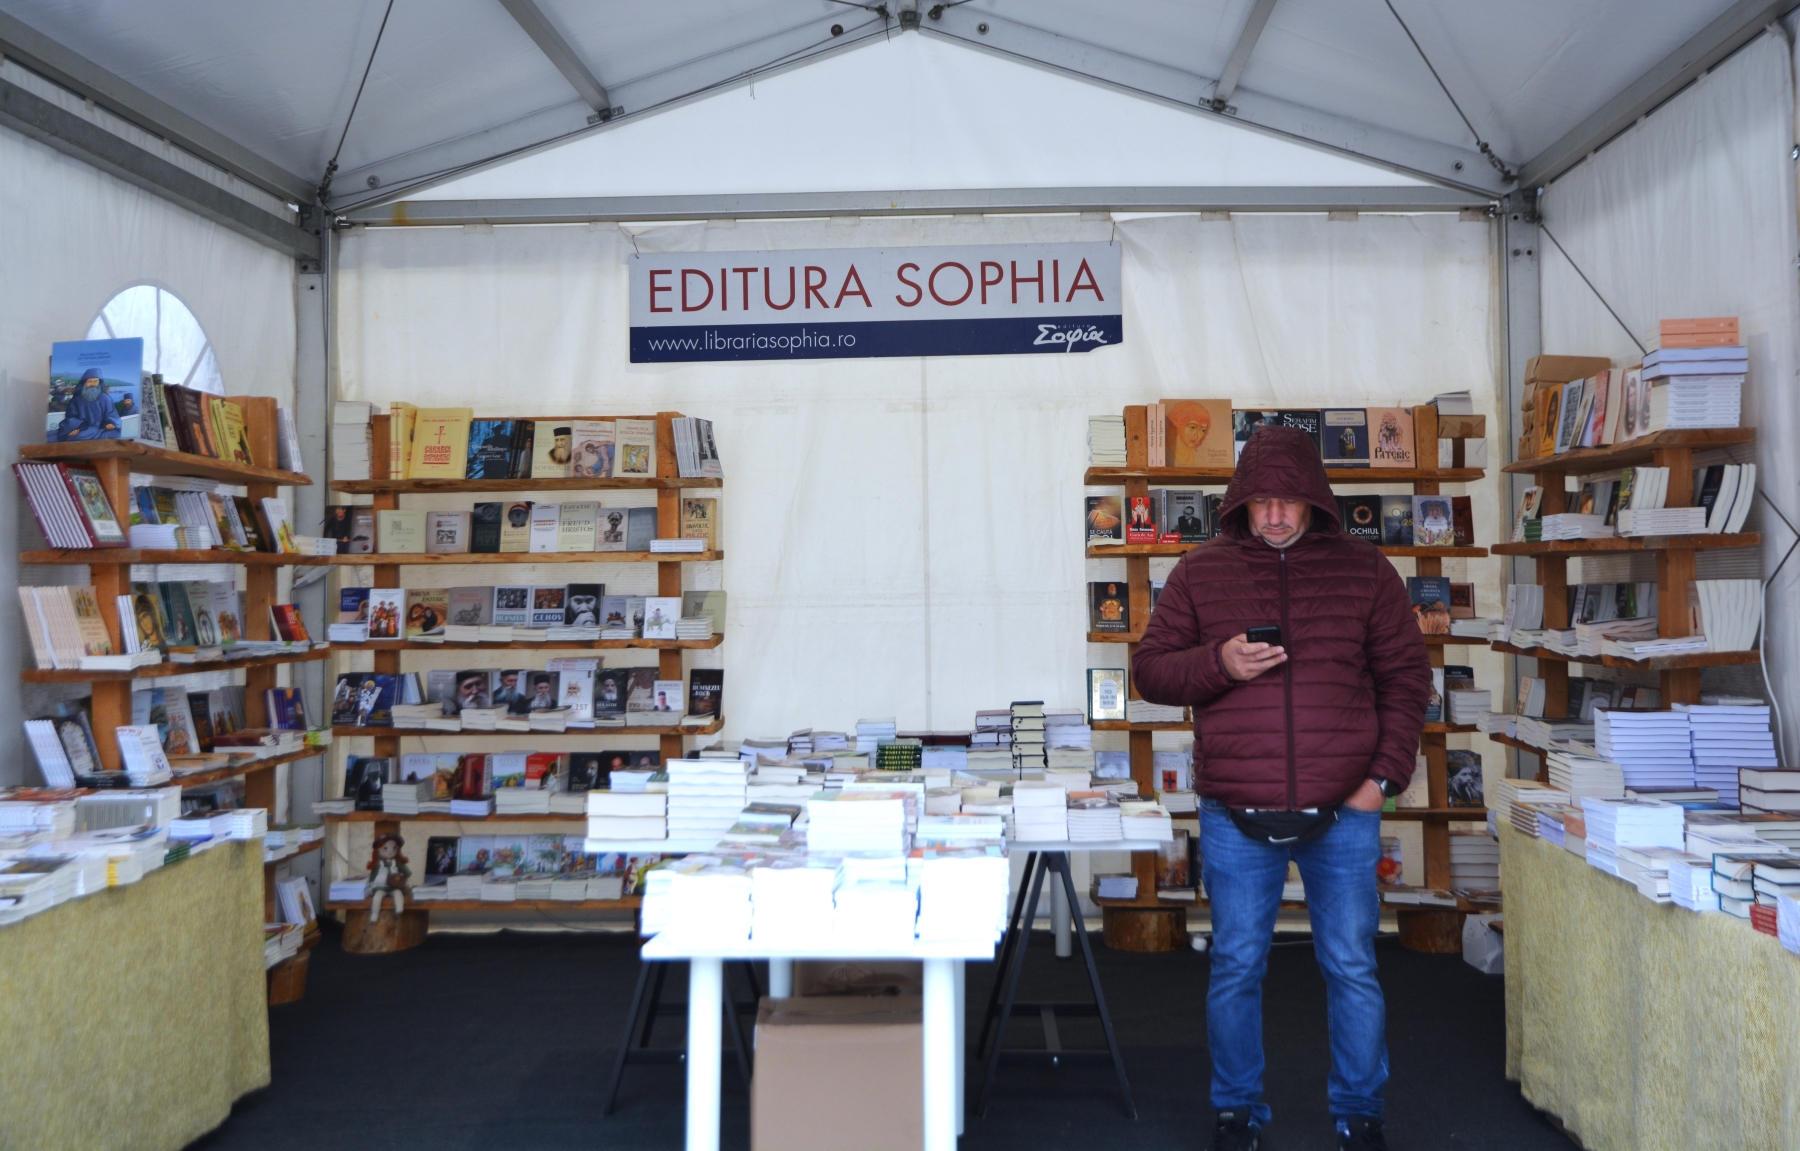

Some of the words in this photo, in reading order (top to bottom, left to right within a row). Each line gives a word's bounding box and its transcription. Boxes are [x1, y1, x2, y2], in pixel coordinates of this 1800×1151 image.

[649, 262, 873, 313] EDITURA
[895, 256, 1105, 307] SOPHIA
[648, 328, 856, 353] www.librariasophia.ro
[1283, 413, 1317, 424] SERAFIM
[1374, 446, 1411, 460] PATERIC
[1403, 518, 1414, 526] 25
[1349, 527, 1380, 535] OCHIUL
